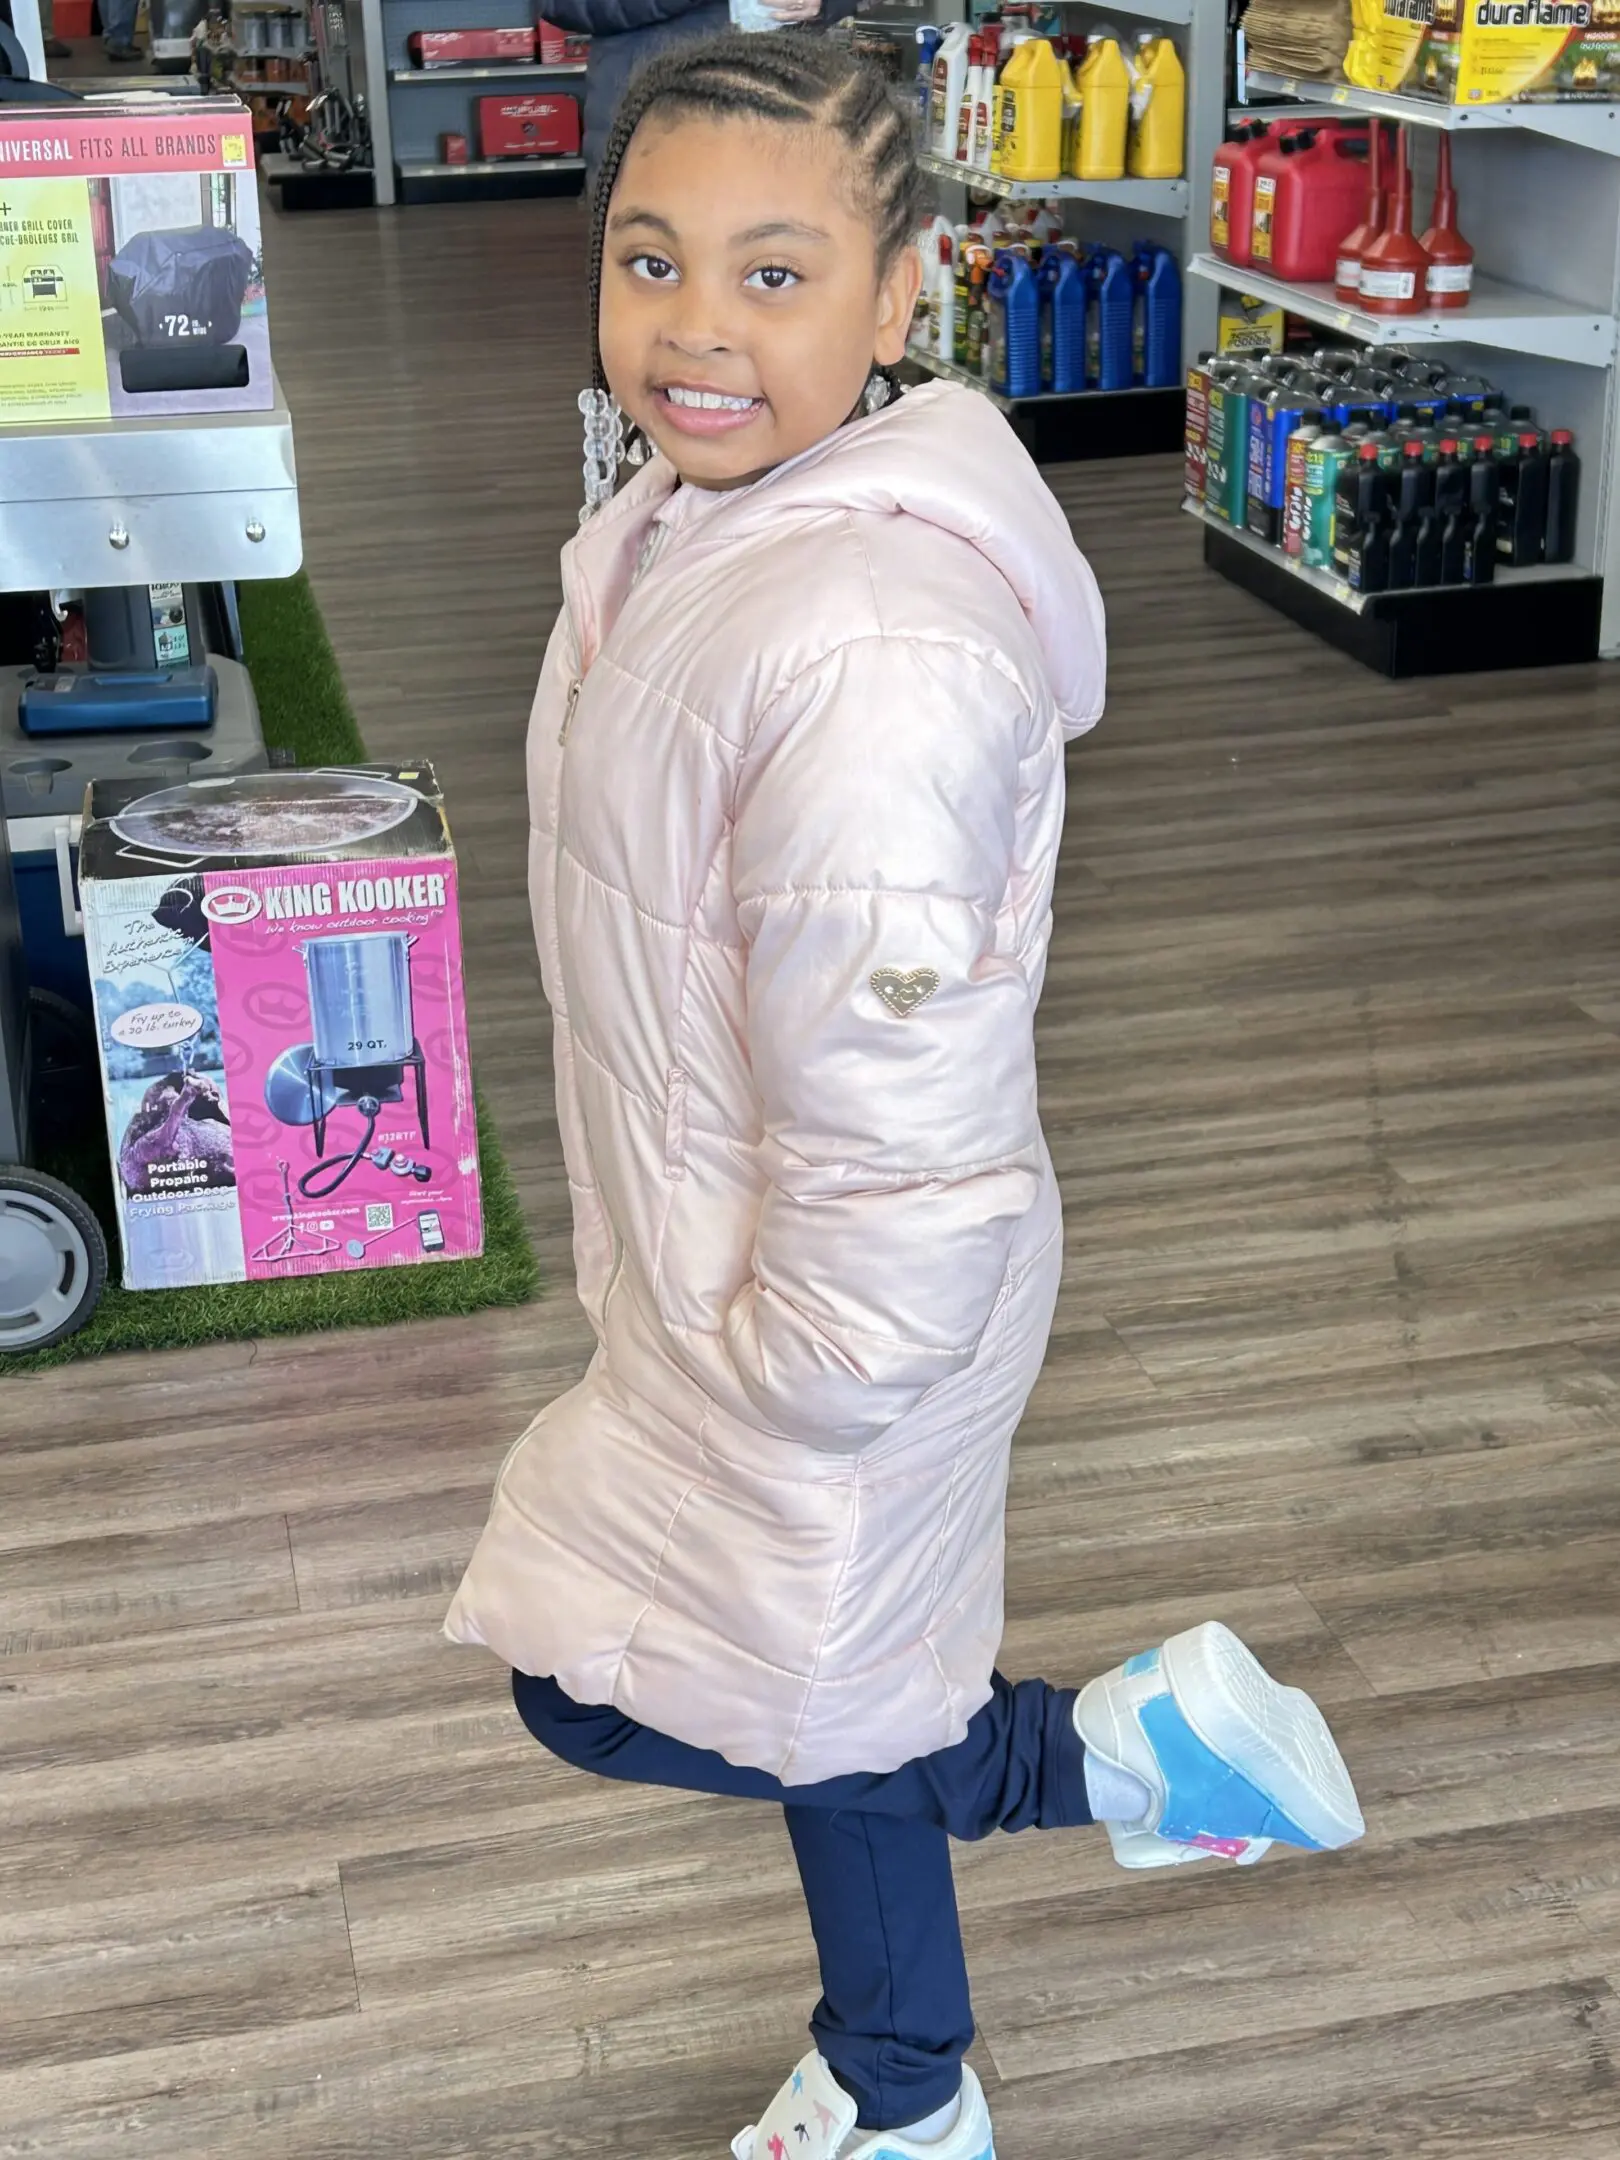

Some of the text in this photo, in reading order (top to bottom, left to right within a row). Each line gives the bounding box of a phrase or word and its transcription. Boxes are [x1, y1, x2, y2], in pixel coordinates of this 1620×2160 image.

[1477, 0, 1590, 26] duraflame
[80, 137, 113, 159] FITS
[121, 136, 148, 157] ALL
[155, 134, 216, 156] BRANDS
[21, 220, 44, 231] GRILL
[47, 219, 73, 230] COVER
[164, 314, 190, 336] 72
[265, 873, 446, 920] KING KOOKER
[290, 921, 323, 933] know
[327, 917, 378, 930] outdoor
[131, 1010, 181, 1024] Fry up to
[163, 1017, 196, 1029] turkey
[347, 1041, 363, 1051] 29
[147, 1158, 208, 1174] Portable
[150, 1174, 208, 1188] Propane
[132, 1188, 191, 1204] Outdoor
[130, 1203, 174, 1220] Frying
